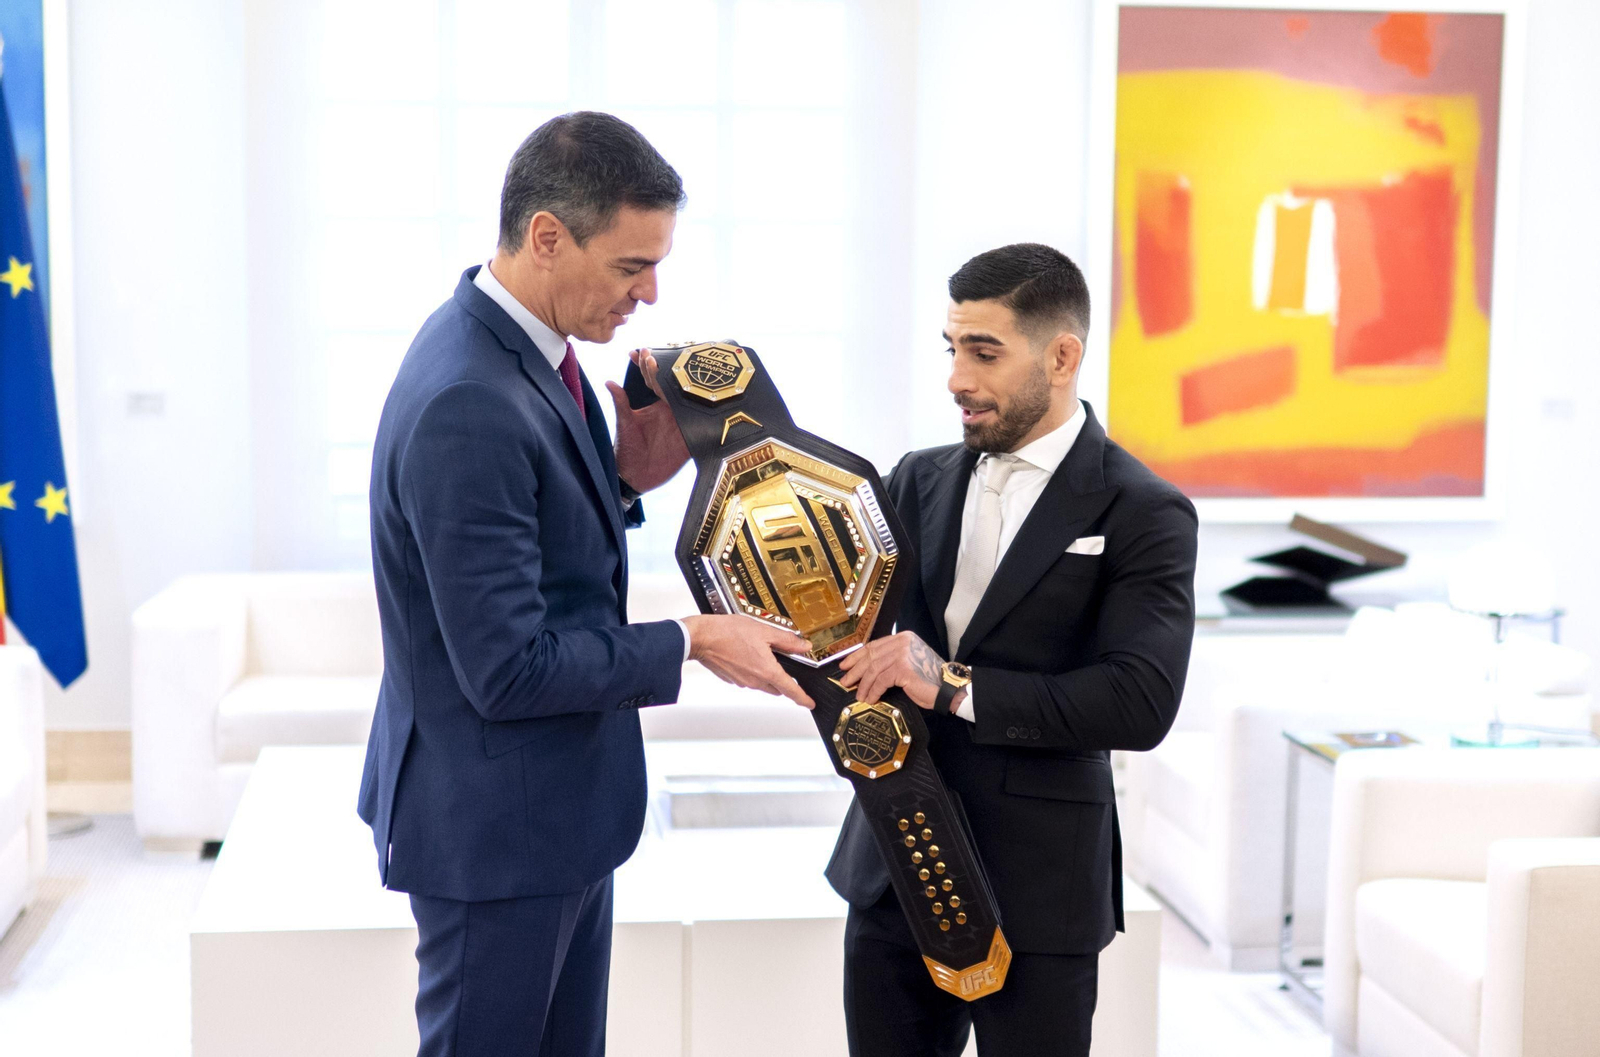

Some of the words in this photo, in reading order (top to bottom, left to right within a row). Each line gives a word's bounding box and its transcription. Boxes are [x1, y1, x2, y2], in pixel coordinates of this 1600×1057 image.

[696, 356, 735, 371] WORLD
[708, 350, 731, 361] UFC
[689, 360, 737, 378] CHAMPION
[818, 514, 848, 569] WORLD
[751, 502, 838, 612] UFC
[738, 541, 775, 610] CHAMPION
[854, 722, 892, 744] WORLD
[864, 715, 889, 731] UFC
[847, 727, 894, 753] CHAMPION
[960, 965, 998, 996] UFC
